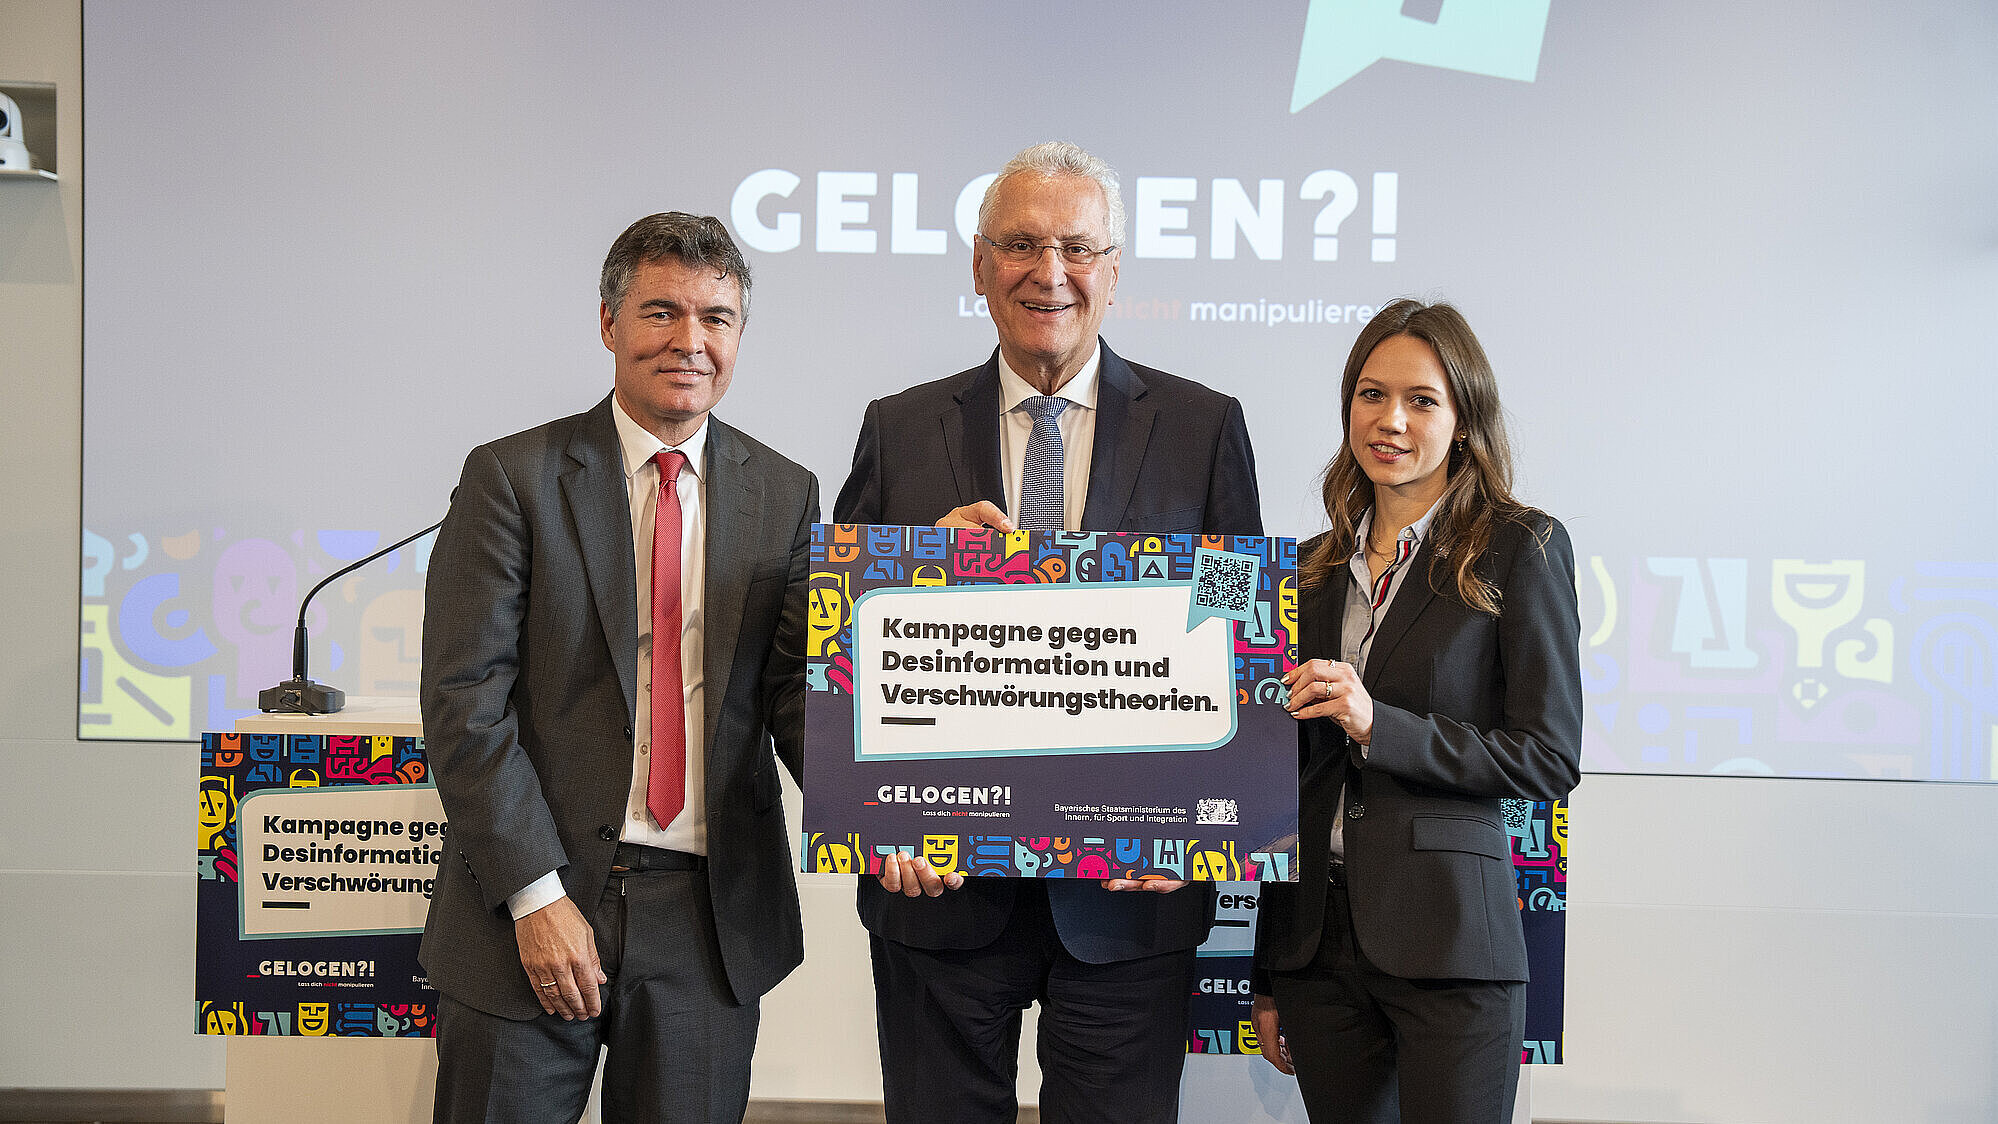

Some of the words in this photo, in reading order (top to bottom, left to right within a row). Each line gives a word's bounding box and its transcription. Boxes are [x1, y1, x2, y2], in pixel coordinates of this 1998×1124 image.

[731, 168, 1399, 263] GELEN?!
[1189, 298, 1386, 327] manipuliere
[882, 617, 1042, 647] Kampagne
[1049, 625, 1136, 650] gegen
[881, 649, 1108, 677] Desinformation
[1114, 656, 1170, 678] und
[881, 683, 1219, 716] Verschwörungstheorien.
[1054, 803, 1099, 813] Bayerisches
[1101, 804, 1171, 814] Staatsministerium
[1172, 806, 1187, 814] des
[1065, 813, 1092, 822] Innern,
[1093, 813, 1105, 822] für
[1106, 814, 1128, 823] Sport
[1146, 815, 1188, 824] Integration
[263, 815, 404, 841] Kampagne
[408, 818, 449, 842] geg
[263, 842, 441, 865] Desinformatio
[262, 872, 436, 899] Verschwörung
